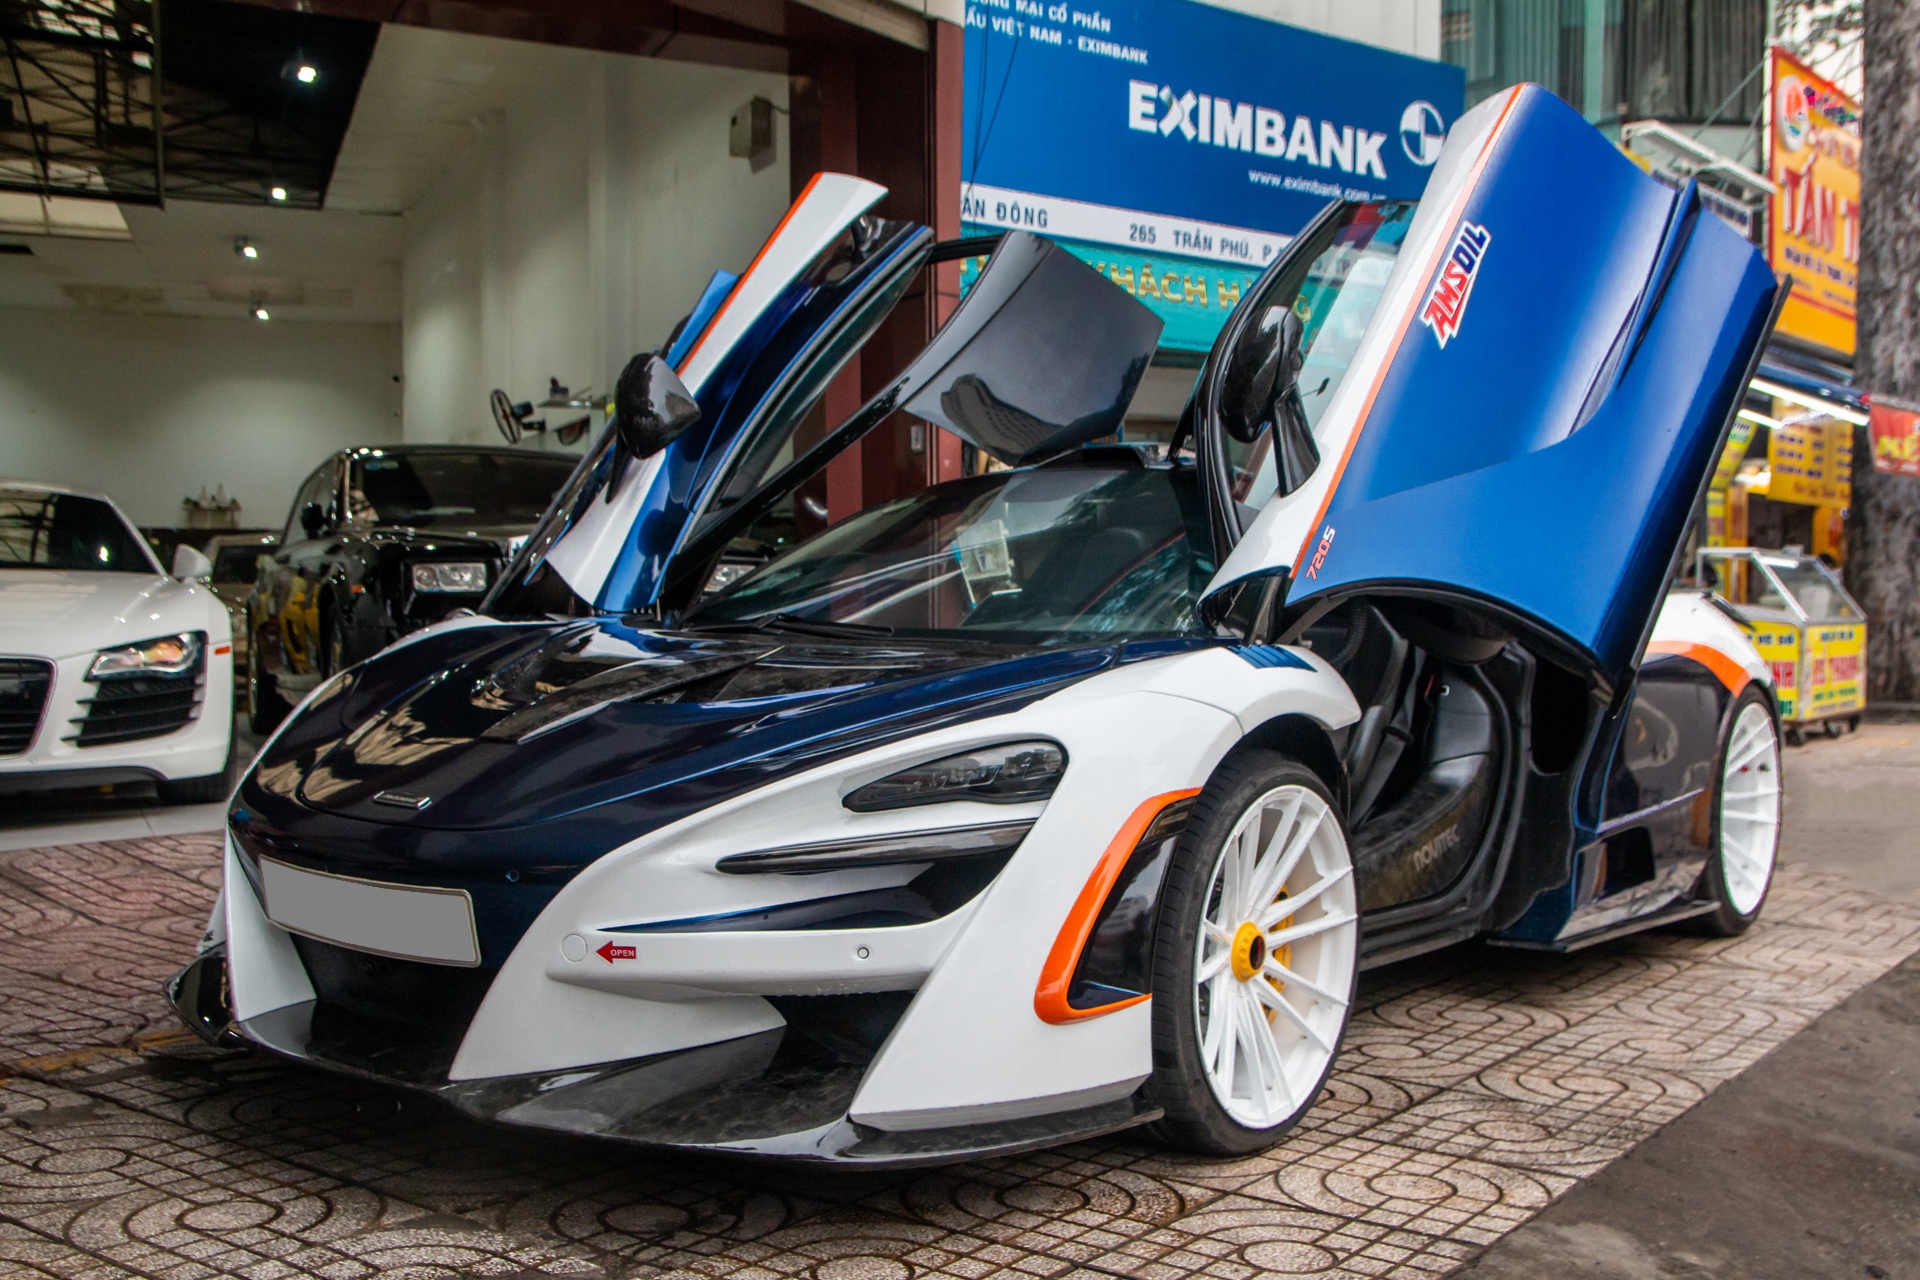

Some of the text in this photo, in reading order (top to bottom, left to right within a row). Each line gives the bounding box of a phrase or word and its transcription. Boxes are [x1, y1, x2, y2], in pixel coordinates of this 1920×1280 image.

[1030, 25, 1062, 46] NAM
[1078, 35, 1148, 64] EXIMBANK
[1128, 79, 1388, 180] EXIMBANK
[996, 201, 1048, 228] ĐÔNG
[1130, 223, 1156, 244] 265
[1087, 259, 1208, 307] HÁCH
[1422, 222, 1490, 344] AMSOIL
[1305, 525, 1336, 581] 720S
[610, 949, 635, 957] OPEN
